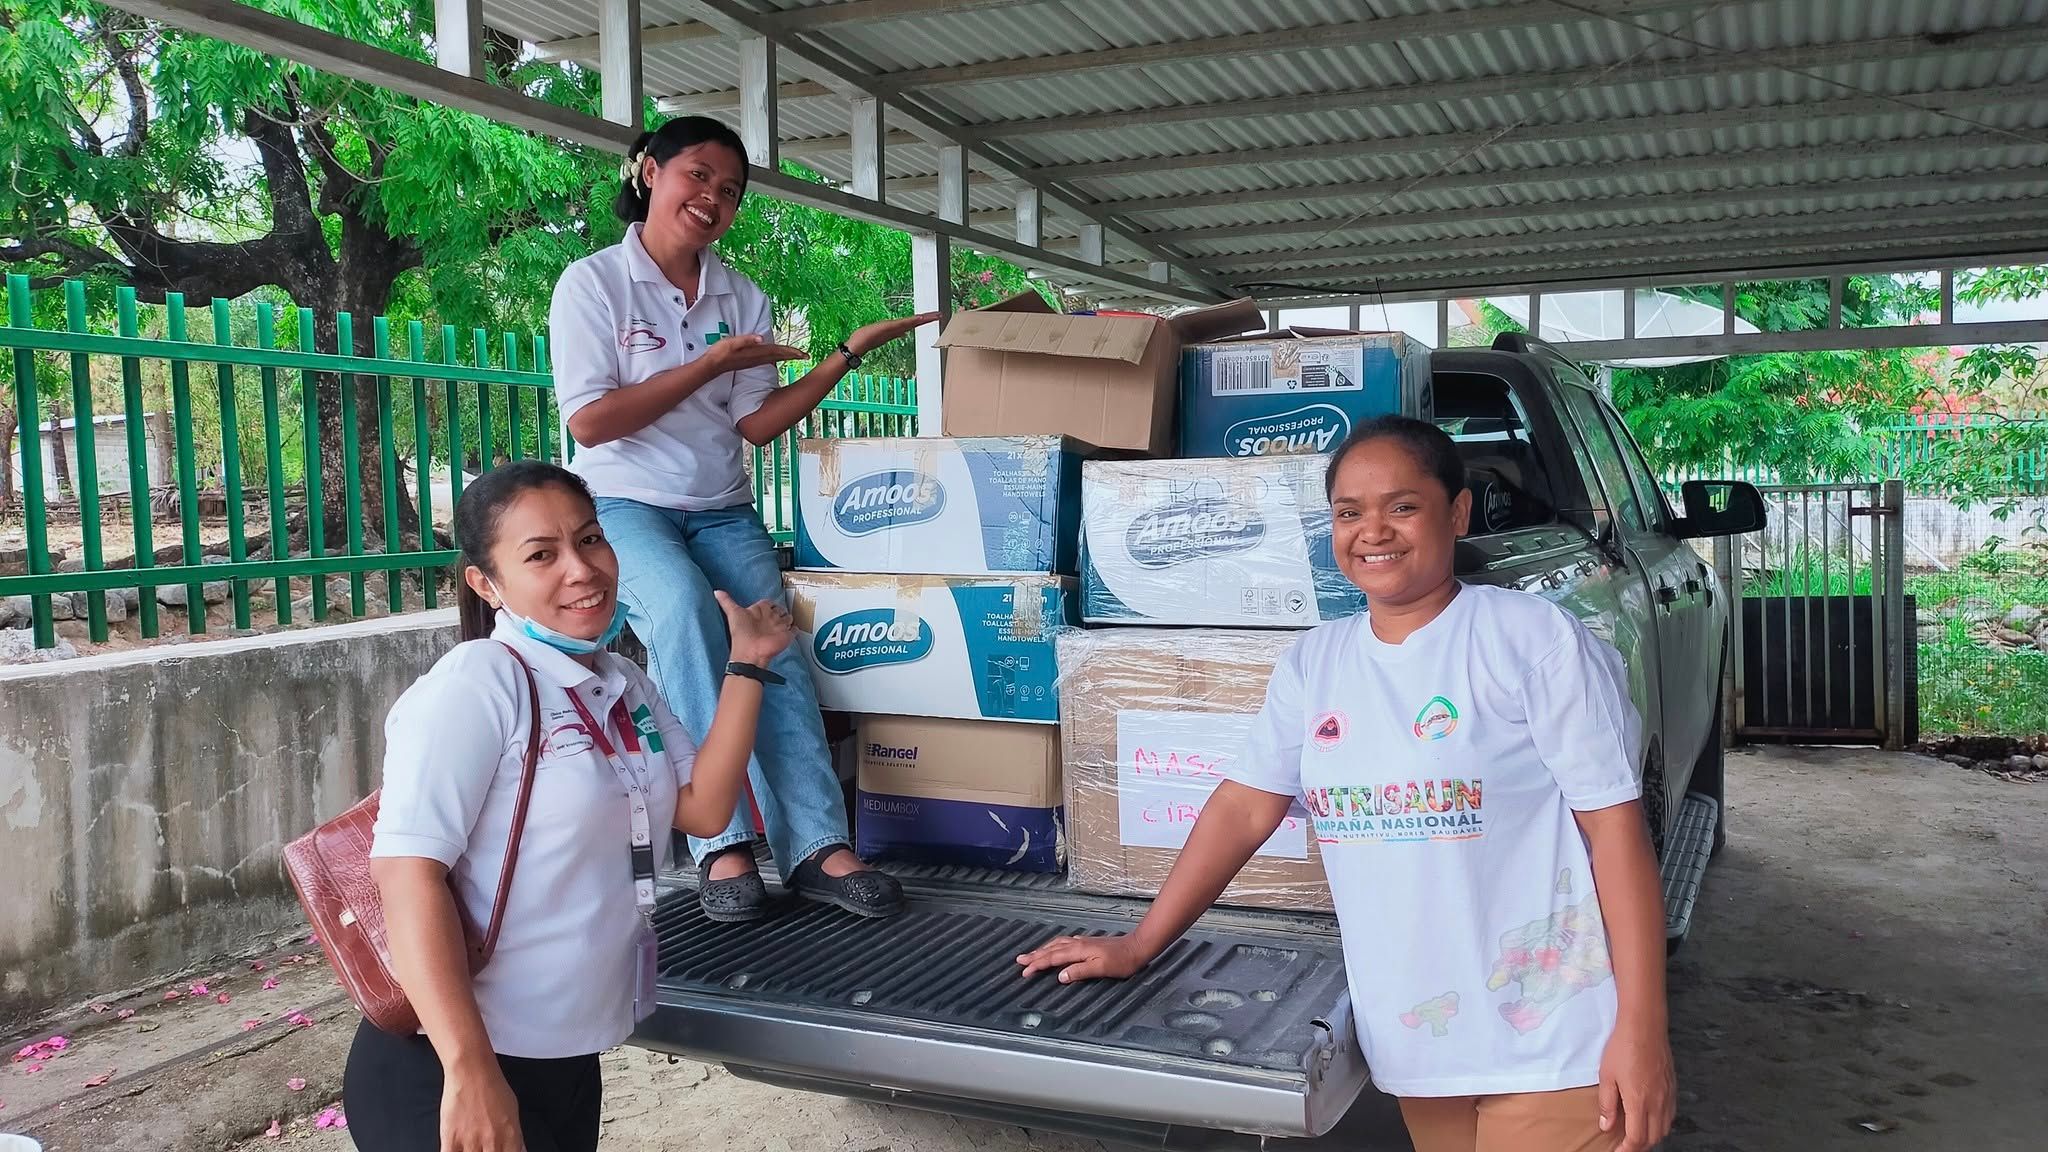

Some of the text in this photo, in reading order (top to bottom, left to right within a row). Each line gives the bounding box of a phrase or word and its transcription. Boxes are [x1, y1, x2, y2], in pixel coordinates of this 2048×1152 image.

[1248, 415, 1324, 435] PROFESSIONAL
[1238, 423, 1340, 456] Amoos
[839, 482, 932, 516] Amoos
[852, 507, 922, 524] PROFESSIONAL
[1135, 510, 1248, 546] Amoos
[1150, 534, 1237, 556] PROFESSIONAL
[982, 620, 1014, 628] TOALLAS
[820, 619, 922, 651] Amoos
[997, 635, 1047, 643] HANDTOWELS
[834, 644, 909, 661] PROFESSIONAL
[1381, 811, 1483, 831] NASIONÁL
